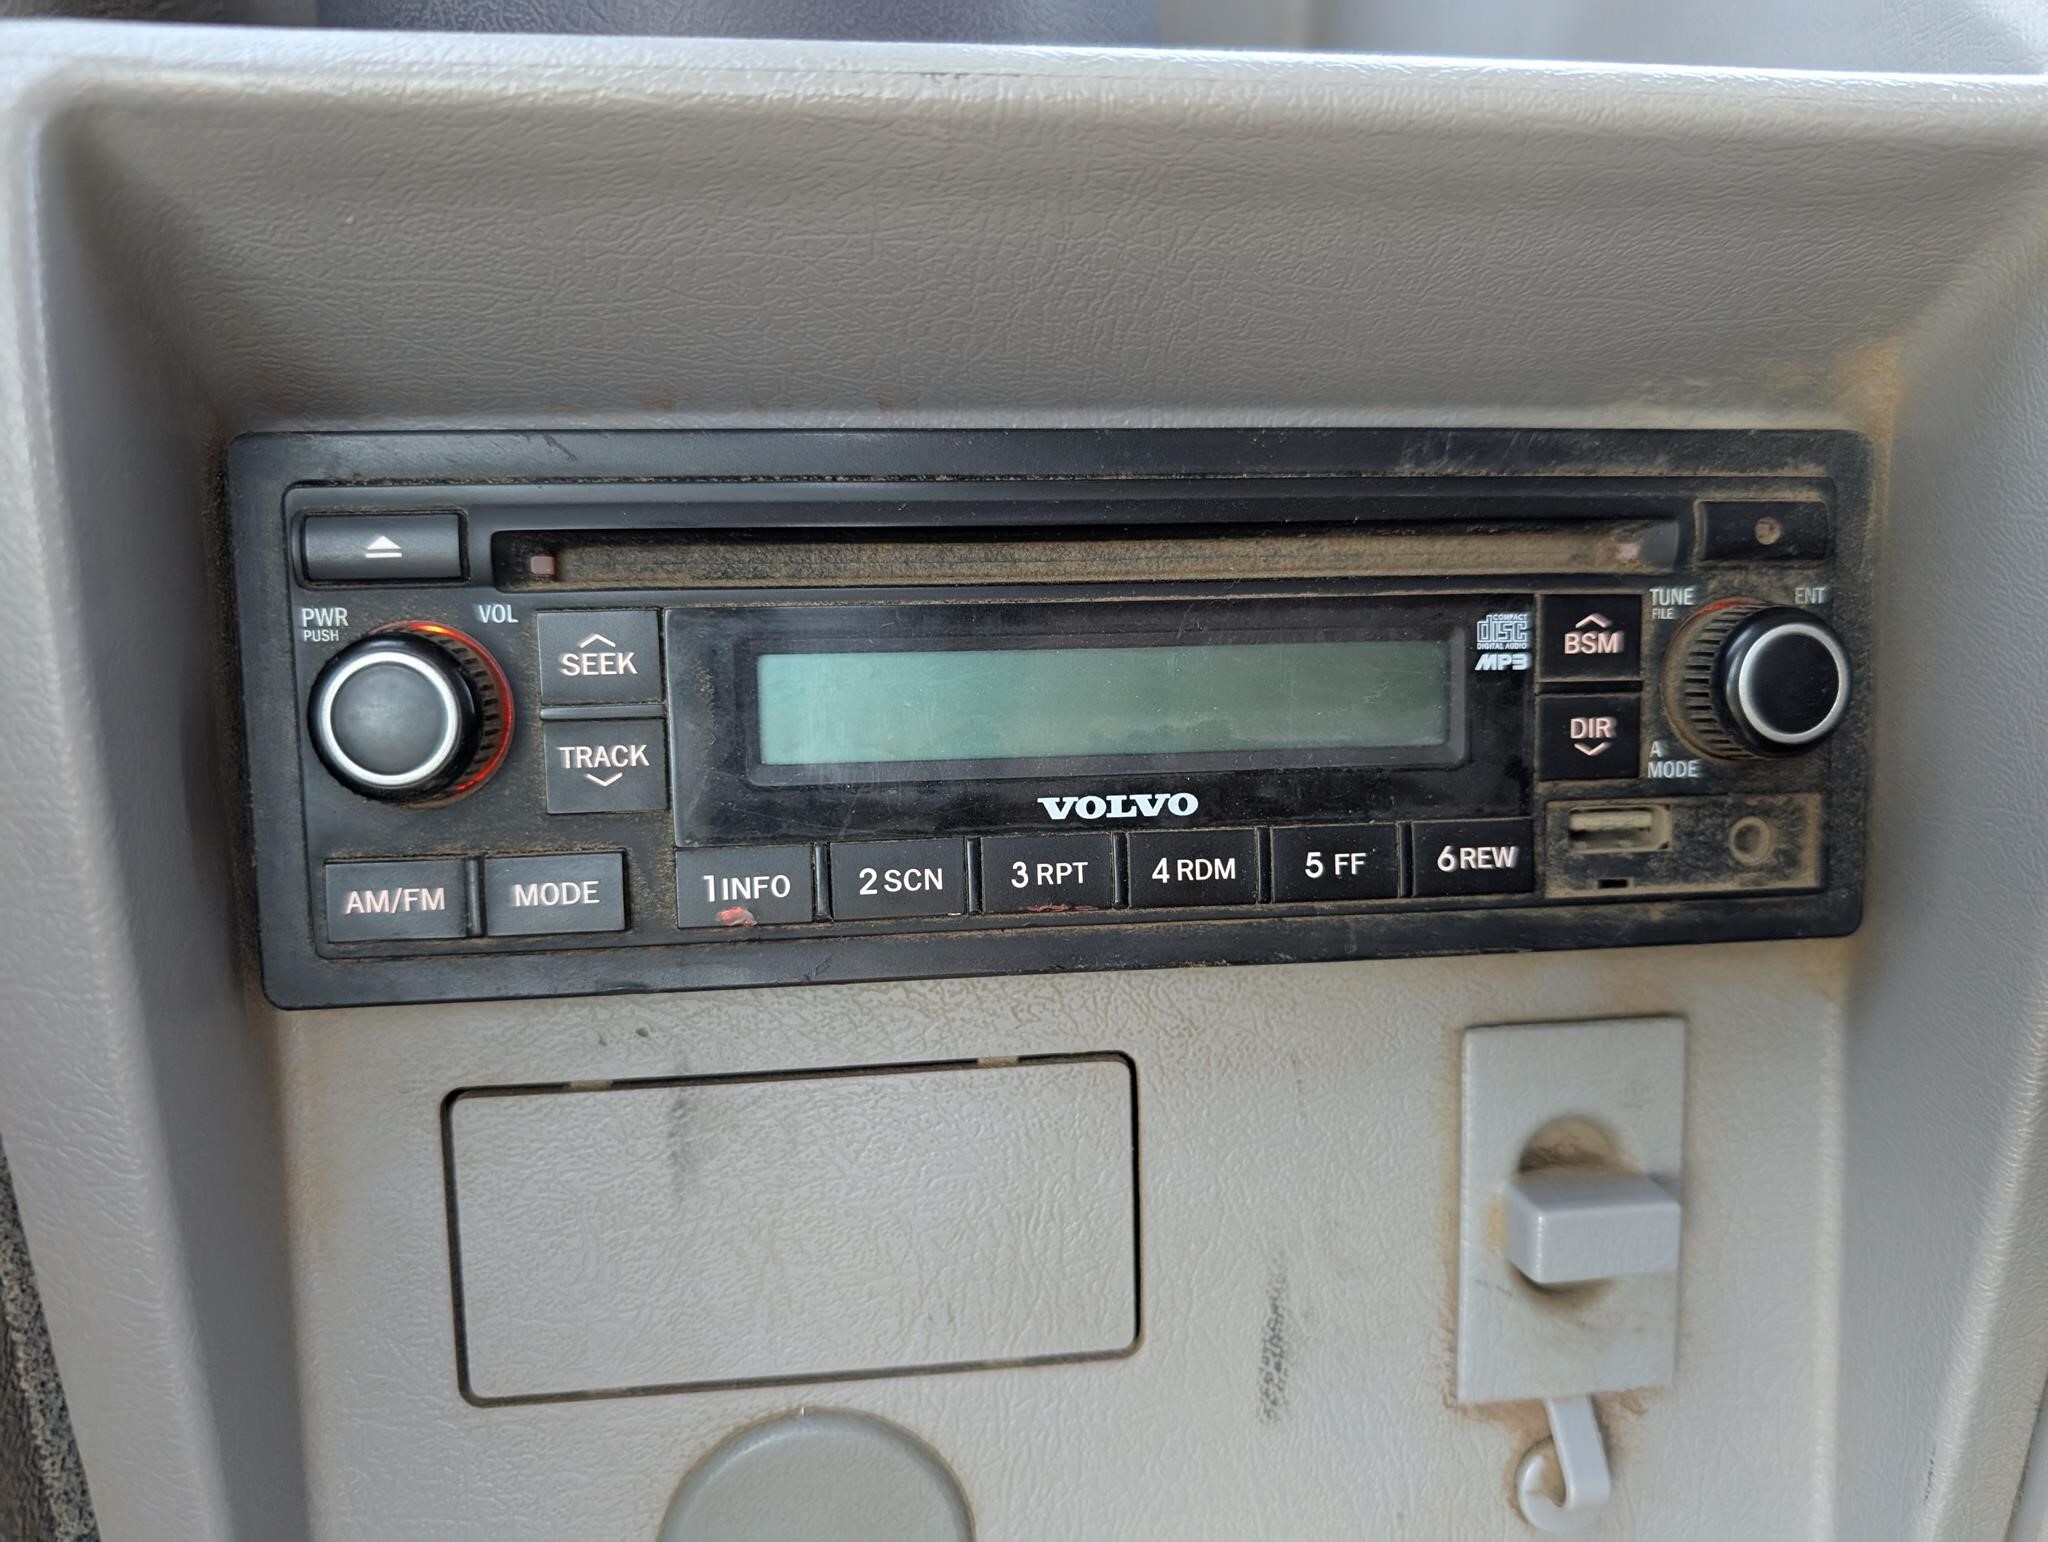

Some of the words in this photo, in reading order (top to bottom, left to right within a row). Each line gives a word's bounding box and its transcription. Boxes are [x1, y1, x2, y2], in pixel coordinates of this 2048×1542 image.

[1649, 587, 1696, 606] TUNE
[1794, 586, 1827, 605] ENT
[301, 607, 349, 628] PWR
[478, 604, 519, 624] VOL
[303, 629, 340, 642] PUSH
[1476, 642, 1503, 650] DIGITAL
[1504, 642, 1529, 650] AUDIO
[1564, 633, 1622, 655] BSM
[561, 652, 638, 676] SEEK
[1475, 653, 1531, 671] MP3
[1570, 717, 1616, 739] DIR
[559, 744, 650, 770] TRACK
[1649, 741, 1662, 757] A
[1648, 760, 1701, 778] MODE
[1037, 793, 1199, 820] VOLVO
[1010, 861, 1030, 889] 3
[1036, 861, 1089, 886] RPT
[1150, 858, 1171, 885] 4
[1177, 857, 1237, 881] RDM
[1304, 851, 1324, 878] 5
[1334, 851, 1367, 876] FF
[858, 867, 879, 894] 2
[884, 865, 944, 892] SCN
[345, 886, 446, 915] AM/FM
[513, 881, 601, 908] MODE
